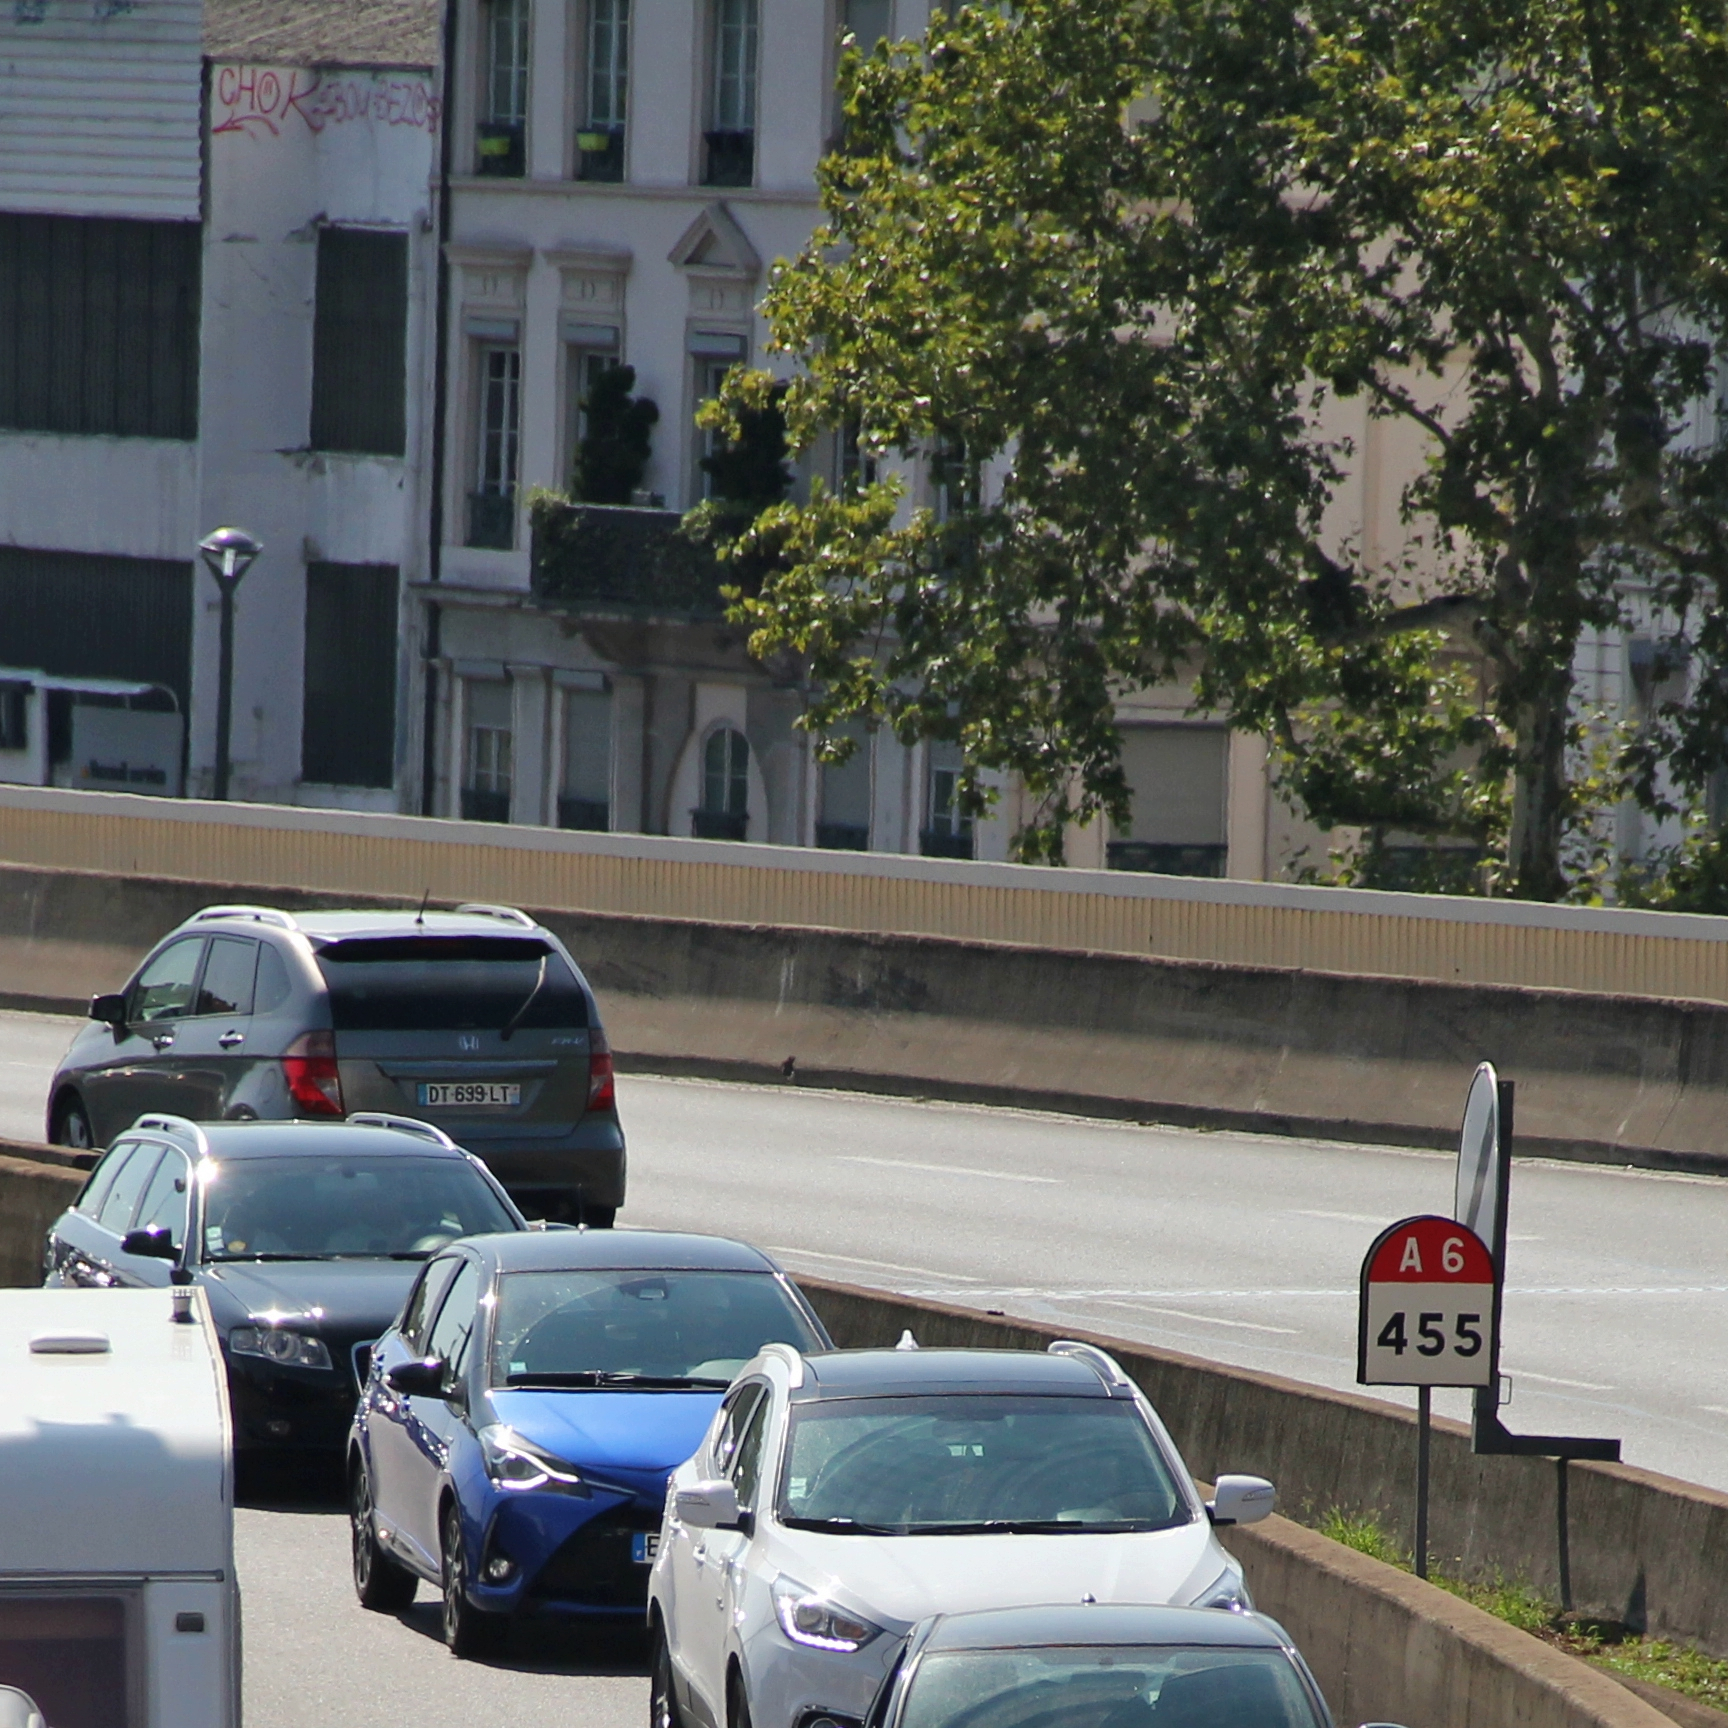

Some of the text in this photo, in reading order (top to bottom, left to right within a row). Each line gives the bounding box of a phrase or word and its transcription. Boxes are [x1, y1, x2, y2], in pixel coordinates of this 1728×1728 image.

[429, 1086, 510, 1103] DT-699-LT
[1399, 1236, 1465, 1273] A 6
[1377, 1312, 1483, 1357] 455
